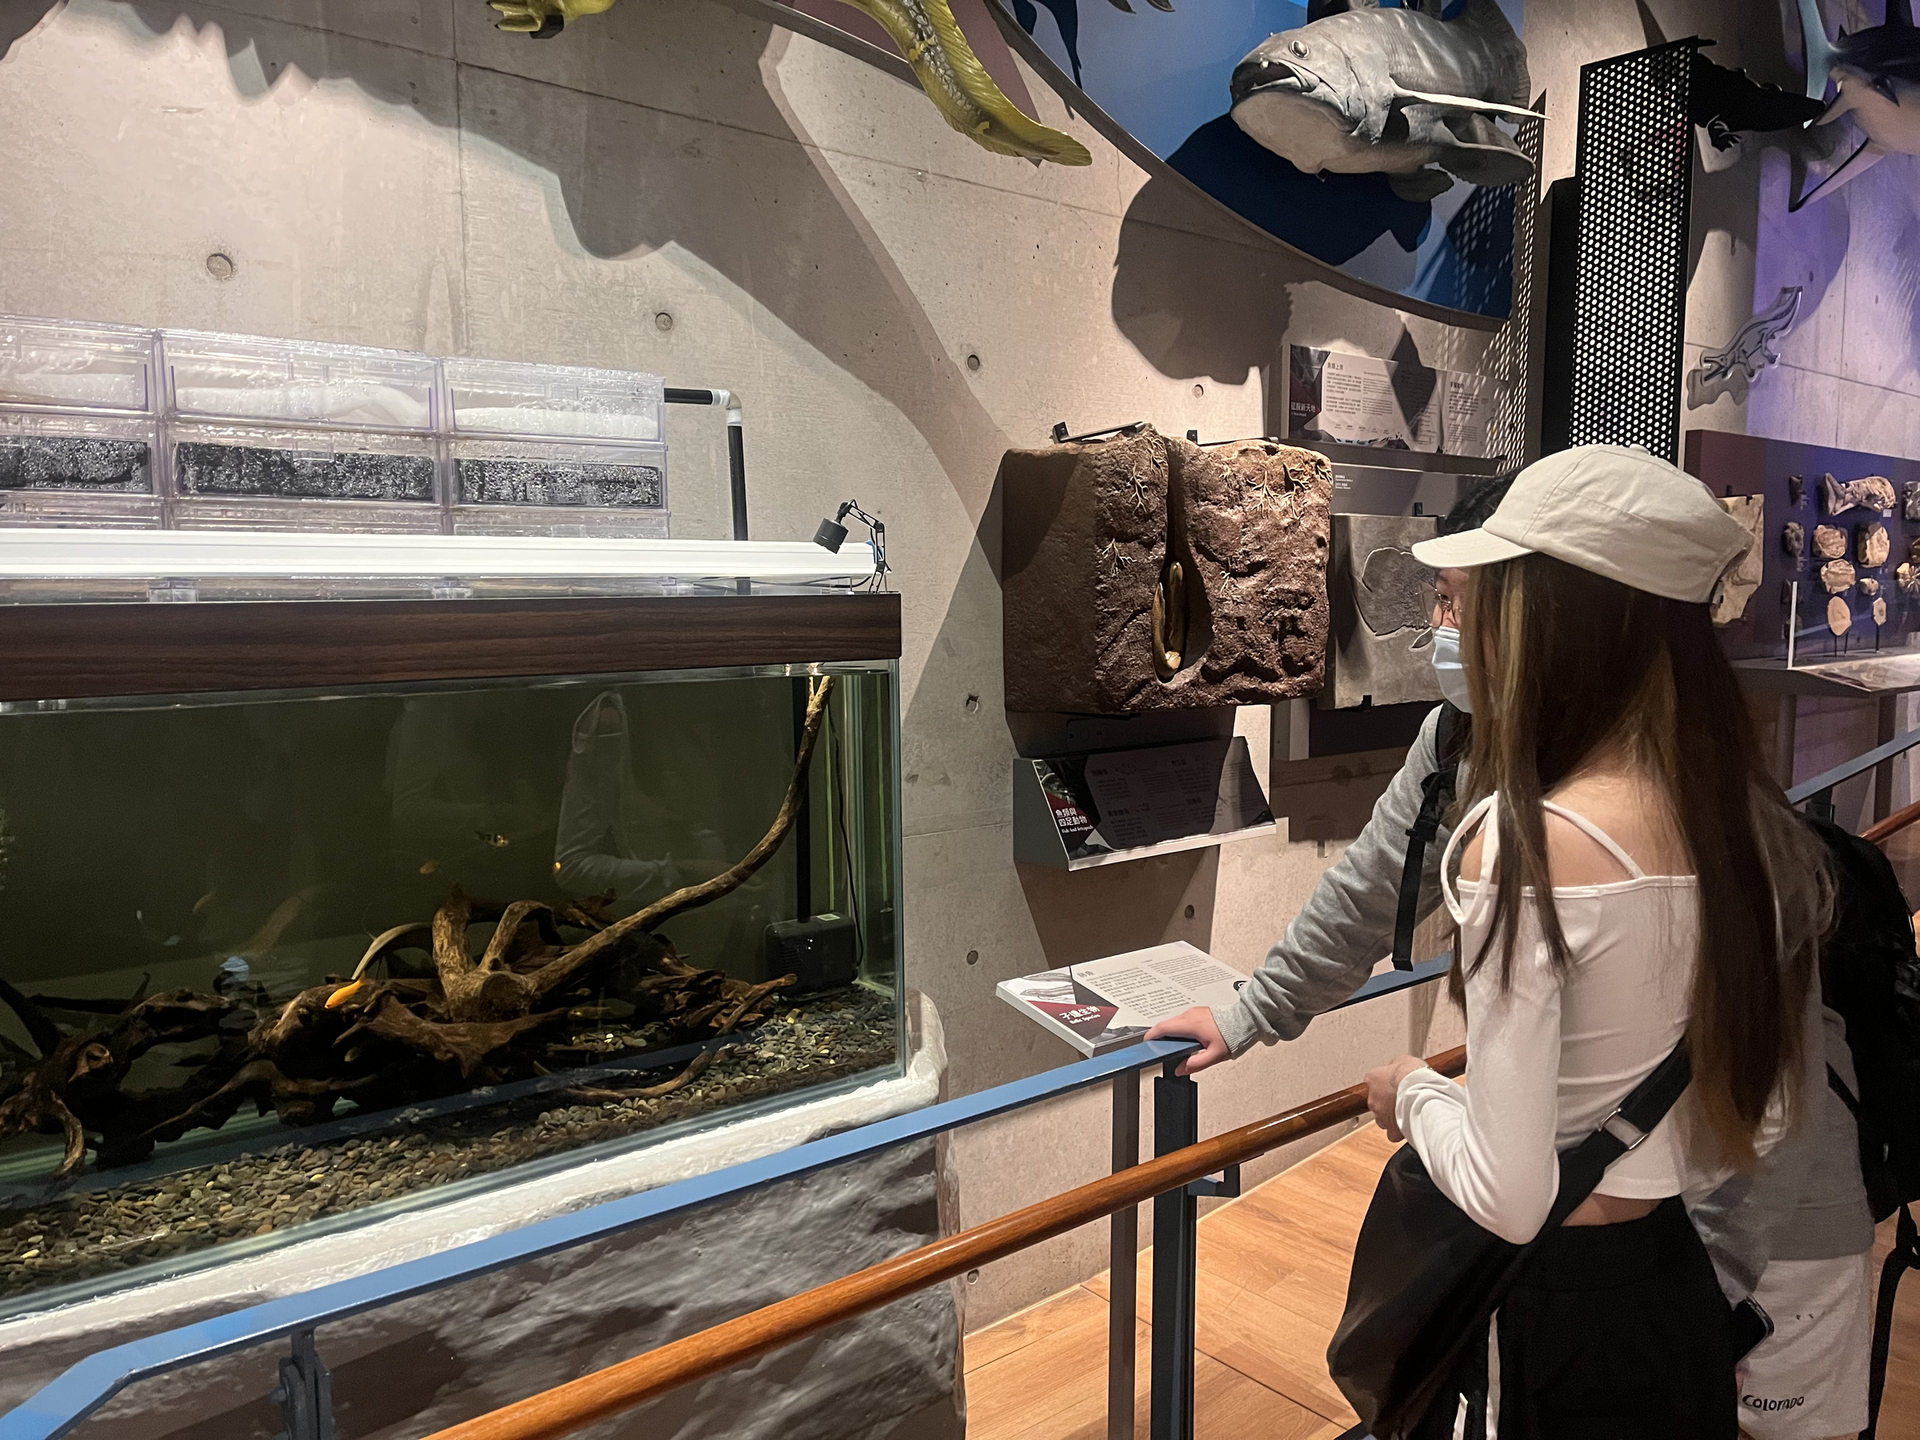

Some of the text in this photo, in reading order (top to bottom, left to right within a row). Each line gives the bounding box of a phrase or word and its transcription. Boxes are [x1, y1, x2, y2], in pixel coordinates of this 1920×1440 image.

[1291, 401, 1316, 413] 征服新天地
[1055, 807, 1078, 819] 魚類與
[1058, 814, 1088, 827] 四足動物
